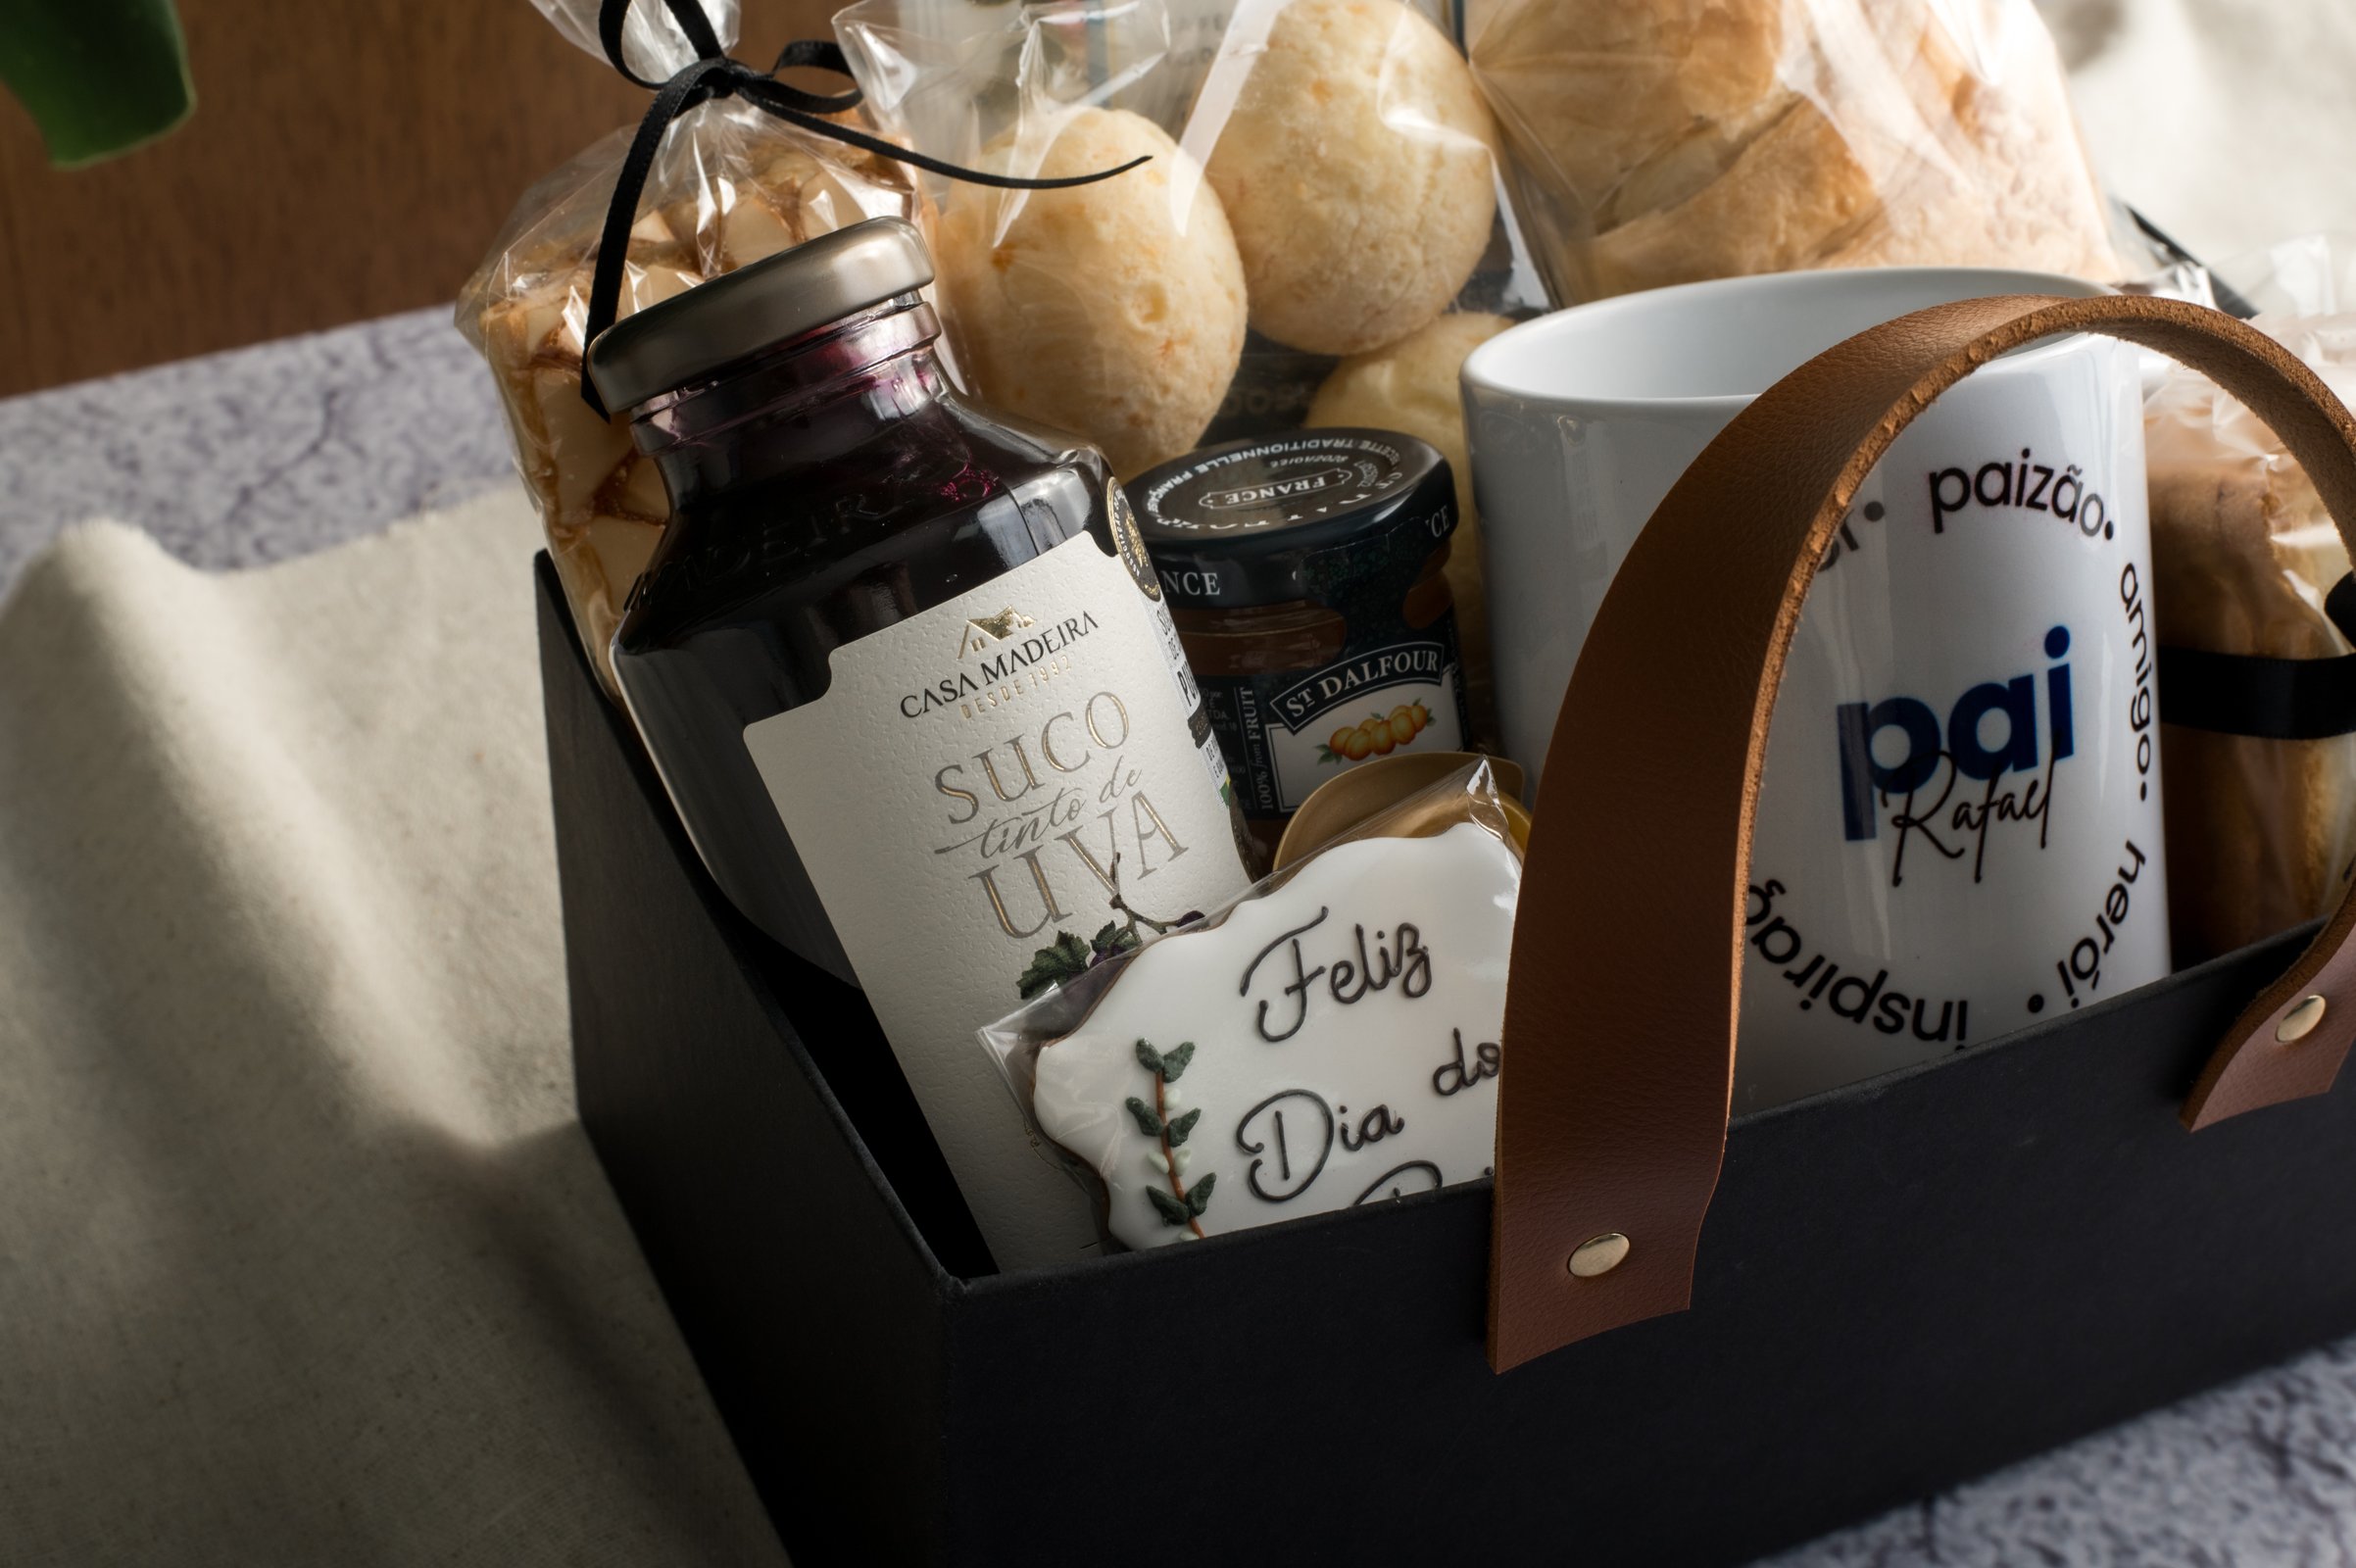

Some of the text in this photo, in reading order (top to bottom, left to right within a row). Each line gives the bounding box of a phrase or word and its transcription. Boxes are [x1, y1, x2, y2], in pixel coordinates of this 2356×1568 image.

[1194, 438, 1354, 473] TRADITIONNELLE
[1225, 476, 1327, 505] FRANCE
[1928, 448, 2107, 538] paizão
[900, 671, 980, 719] CASA
[981, 610, 1100, 686] MADEIRA
[960, 679, 1023, 720] DESDE
[1240, 686, 1262, 740] FRUIT
[1318, 650, 1440, 700] DALFOUR
[2120, 563, 2152, 775] amigo
[934, 691, 1130, 825] SUCO
[1836, 624, 2076, 843] pai
[934, 755, 1142, 859] tinto de
[1881, 749, 2056, 888] Rafael
[968, 790, 1190, 940] UVA
[1240, 906, 1433, 1043] Feliz
[1744, 878, 1969, 1049] inspiraç
[2056, 839, 2147, 1009] herói
[1236, 1088, 1405, 1203] Dia
